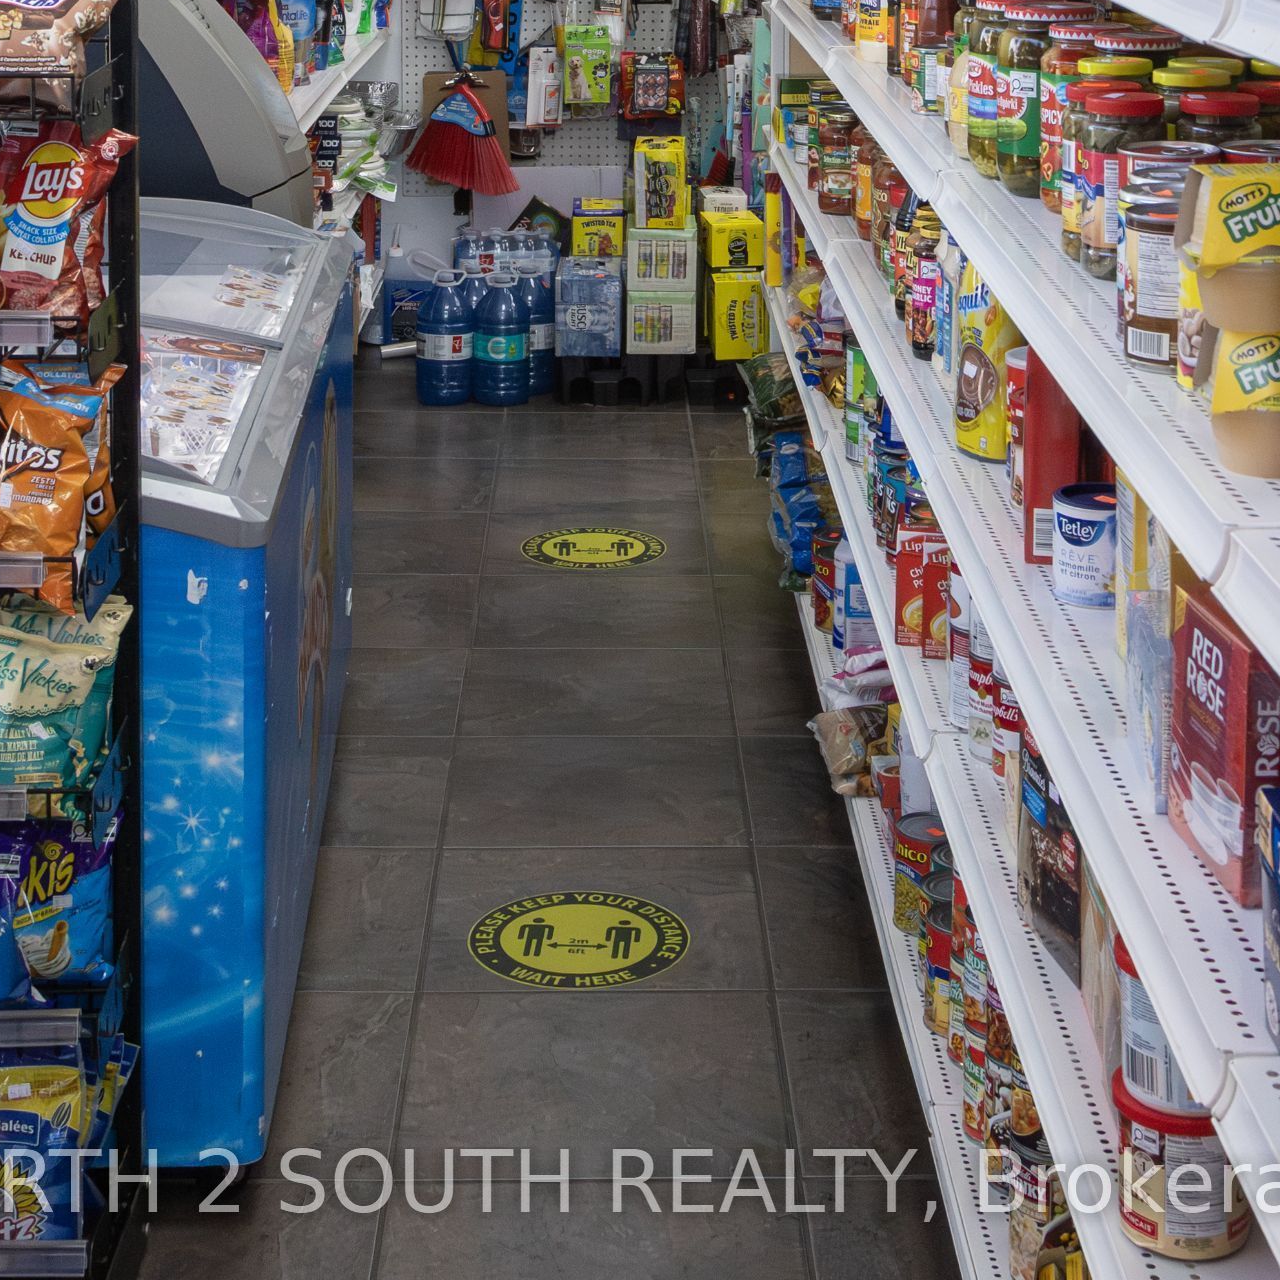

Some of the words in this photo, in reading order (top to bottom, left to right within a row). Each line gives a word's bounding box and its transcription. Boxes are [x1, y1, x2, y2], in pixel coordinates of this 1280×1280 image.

[23, 162, 85, 202] Lay's
[1224, 190, 1267, 212] MOTT'S
[959, 284, 991, 312] squik
[1236, 341, 1278, 361] MOTT'S
[1060, 516, 1099, 541] Tetley
[1060, 548, 1096, 564] RÊVE
[1071, 570, 1097, 582] citron
[1190, 626, 1224, 678] RED
[20, 657, 78, 697] Vickie's
[1186, 663, 1227, 722] ROSE
[1255, 698, 1280, 779] ROSE
[477, 911, 510, 955] PLEASE
[511, 893, 565, 913] KEEP
[575, 892, 636, 909] YOUR
[636, 906, 680, 960] DISTANCE
[511, 966, 566, 986] WAIT
[575, 968, 637, 987] HERE
